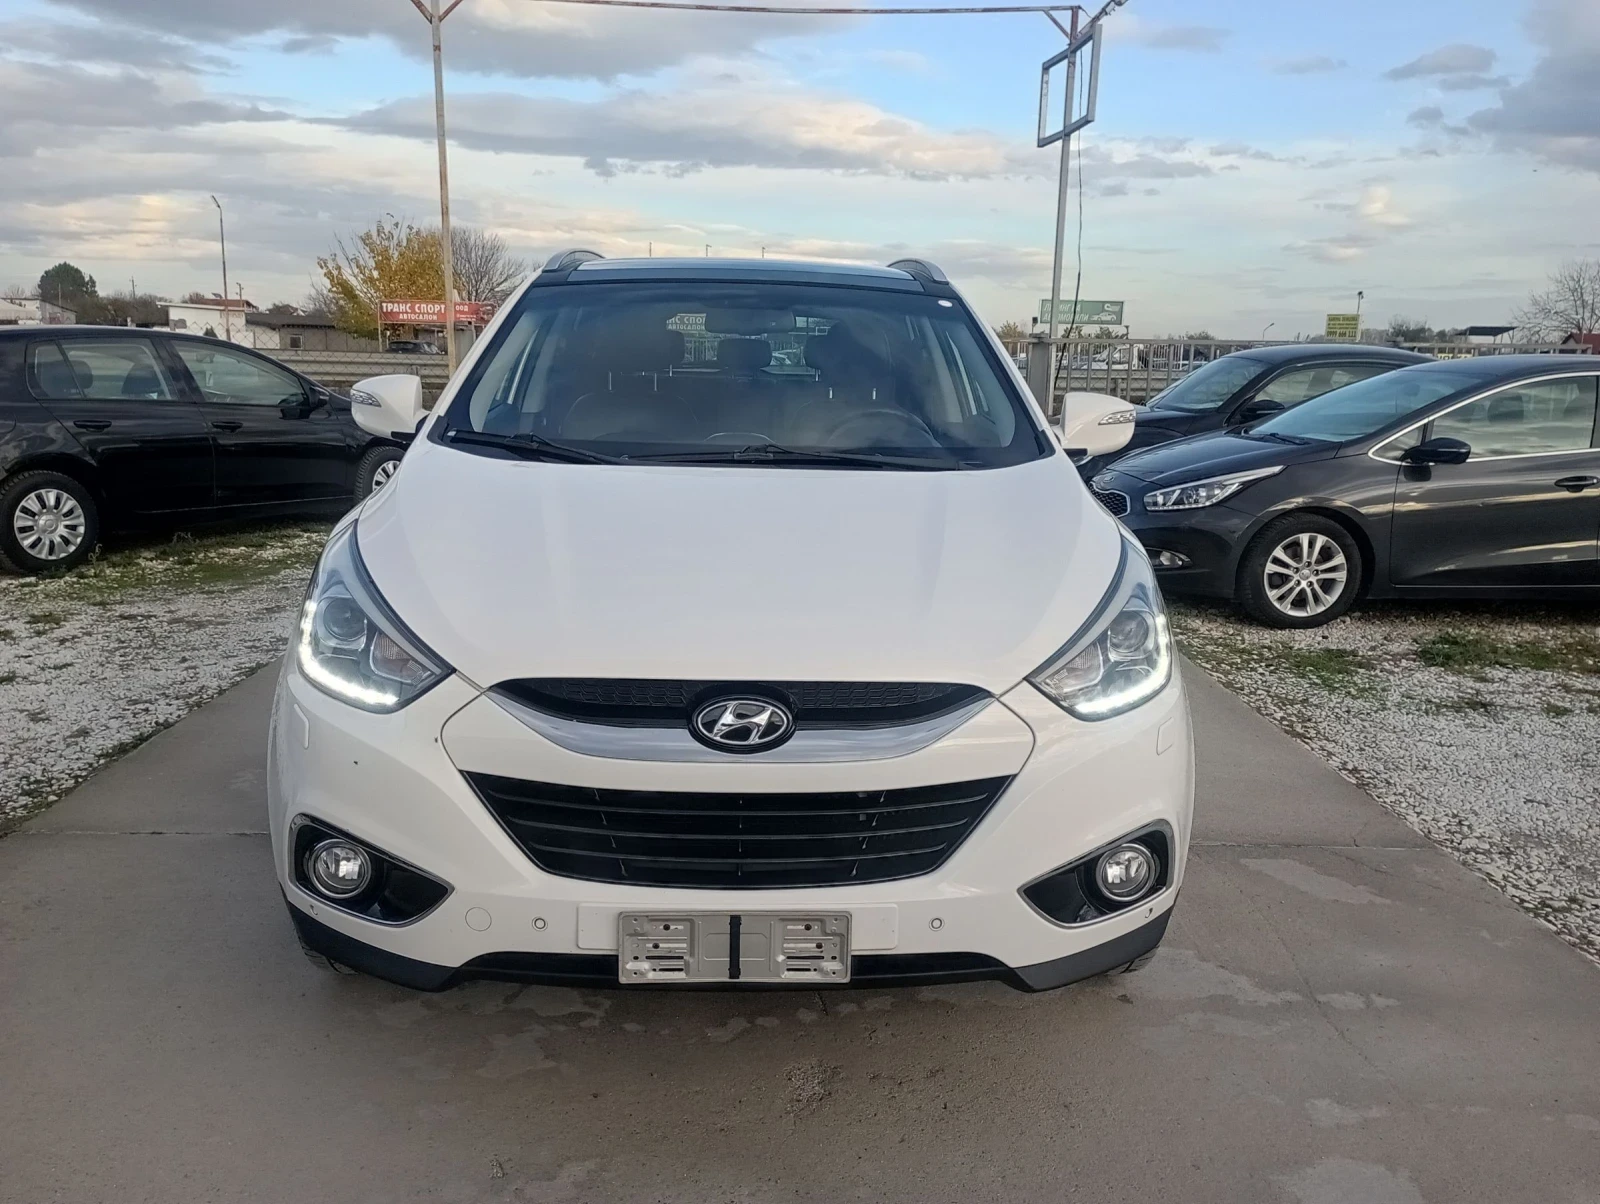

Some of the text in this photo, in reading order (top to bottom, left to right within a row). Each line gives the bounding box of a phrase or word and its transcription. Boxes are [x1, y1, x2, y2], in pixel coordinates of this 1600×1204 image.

[381, 302, 412, 313] ТРАНС
[414, 303, 446, 314] СПОРТ
[399, 313, 437, 321] АВТОСАЛОН
